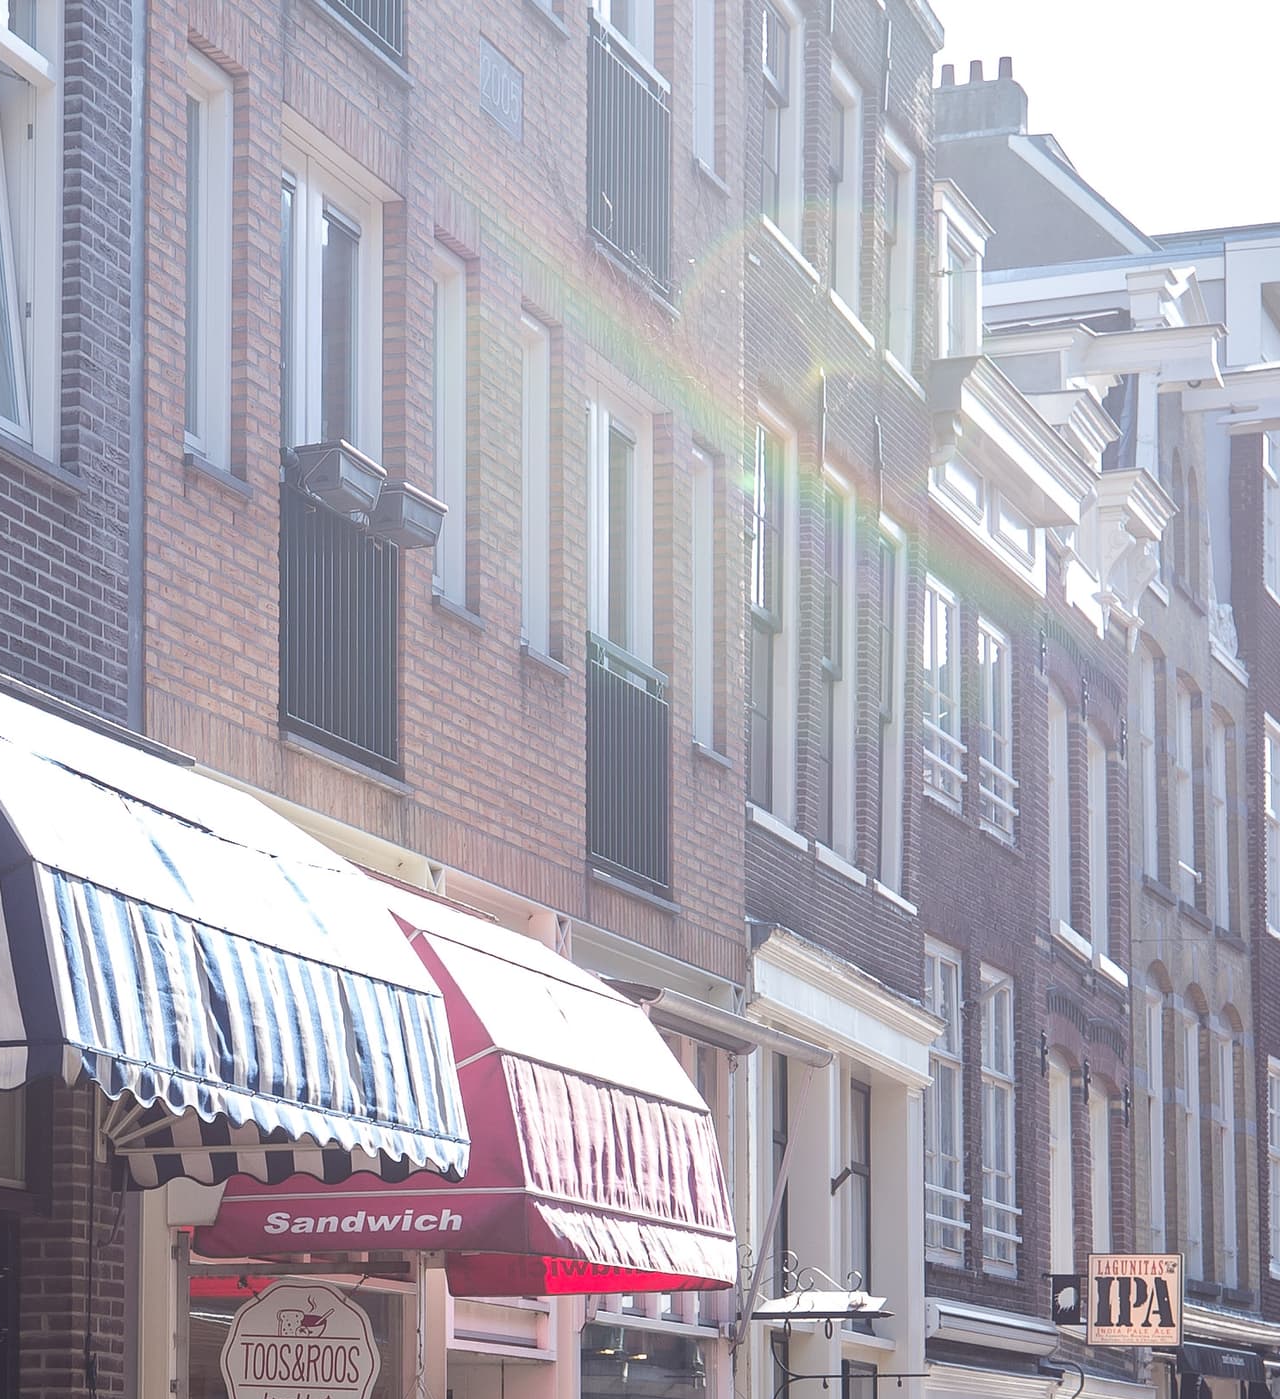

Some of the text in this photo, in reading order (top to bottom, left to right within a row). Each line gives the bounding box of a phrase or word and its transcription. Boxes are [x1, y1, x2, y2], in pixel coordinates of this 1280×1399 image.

[263, 1208, 463, 1235] Sandwich
[1097, 1259, 1164, 1275] LAGUNITAS
[1094, 1276, 1176, 1328] IPA
[240, 1342, 361, 1384] TOOS&ROOS
